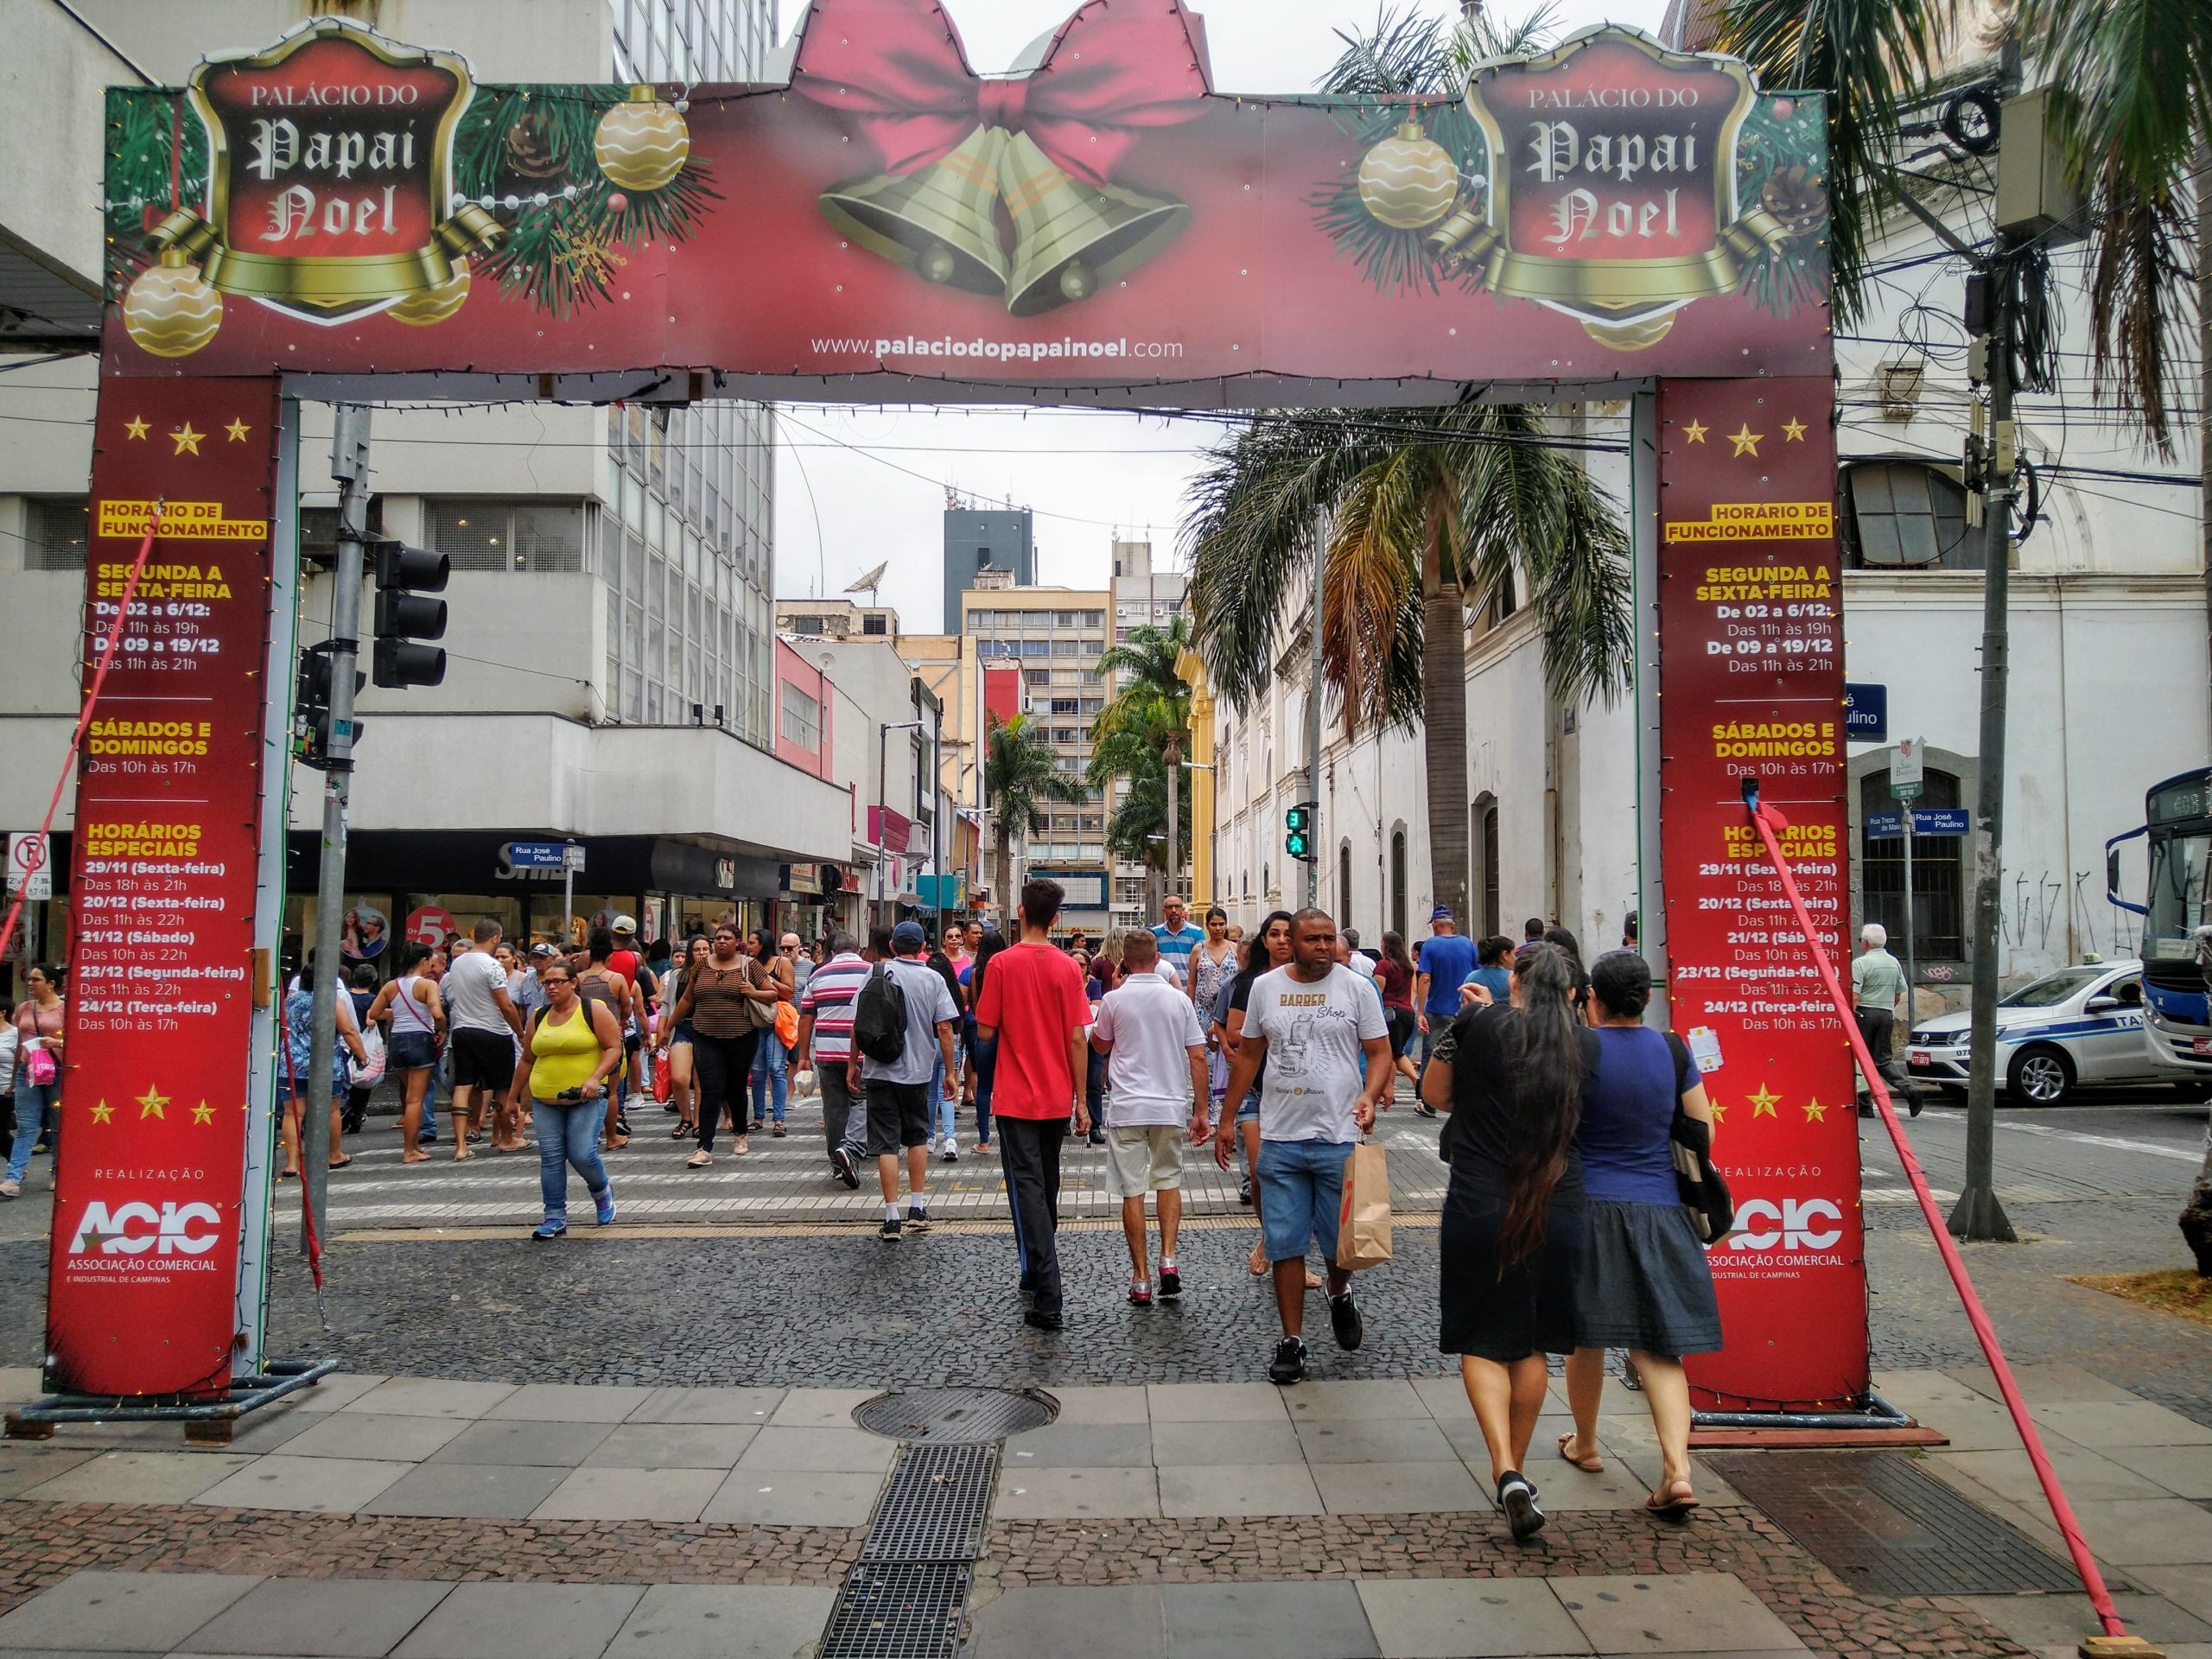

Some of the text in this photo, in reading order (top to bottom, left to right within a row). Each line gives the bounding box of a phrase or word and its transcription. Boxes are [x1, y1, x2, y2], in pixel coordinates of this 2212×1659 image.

[252, 81, 417, 105] PALÁCIO DO
[1529, 84, 1699, 108] PALÁCIO DO
[246, 118, 416, 180] Papai
[1527, 120, 1699, 182] Papai
[260, 184, 398, 241] Noel
[1541, 188, 1681, 243] Noel
[811, 336, 1183, 361] www.palaciodopapainoel.com
[104, 503, 217, 518] HORÁRIO DE
[1716, 504, 1827, 518] HORÁRIO DE
[103, 523, 265, 537] FUNCONAMENTO
[1669, 524, 1828, 538] FUNCIONAMENTO
[99, 564, 222, 580] SEGUNDA A
[1707, 566, 1830, 584] SEGUNDA A
[98, 582, 232, 600] SEXTA-FEIRA
[1697, 582, 1831, 601] SEXTA-FEIRA
[95, 602, 210, 616] De 02 a 6/12:
[1718, 604, 1833, 618] De 02 a 6/12:
[94, 620, 198, 634] Das 11h às 19h
[1728, 623, 1831, 636] Das 11h às 19h
[124, 639, 219, 652] 09 a 19/12
[1707, 639, 1833, 654] De 09 a 19/12
[94, 658, 196, 670] Das 11h às 21h
[1730, 659, 1832, 671] Das 11h às 21h
[1846, 710, 1877, 724] ulino
[90, 718, 210, 736] SÁBADOS E
[1713, 721, 1834, 739] SÁBADOS E
[91, 740, 207, 754] DOMINGOS
[1717, 741, 1834, 757] DOMINGOS
[90, 761, 195, 772] Das 10h às 17h
[1728, 763, 1834, 775] Das 10h às 17h
[89, 821, 200, 839] HORÁRIOS
[86, 842, 197, 856] ESPECIAIS
[86, 862, 225, 876] 29/11 (Sexta-feira)
[1700, 864, 1740, 874] 29/11
[86, 877, 186, 890] Das 18h às 21h
[1738, 880, 1836, 891] Das às 21h
[84, 896, 225, 911] 20/12 (Sexta-feira)
[1700, 898, 1741, 909] 20/12
[84, 914, 183, 925] Das 11h às 22h
[1739, 915, 1837, 927] Das 11h 22h
[82, 931, 194, 945] 21/12 (Sábado)
[1728, 932, 1768, 943] 21/12
[83, 948, 187, 960] Das 10h às 22h
[1736, 947, 1808, 960] Das 10h às
[81, 966, 244, 980] 23/12 (Segunda-feira)
[1677, 967, 1720, 979] 23/12
[81, 982, 181, 995] Das 11h às 22h
[1742, 982, 1808, 995] Das 11h às
[79, 999, 217, 1015] 24/12 (Terça-feira)
[1280, 994, 1326, 1006] BARBER
[1705, 1001, 1747, 1013] 24/12
[1317, 1007, 1346, 1021] Shop
[2118, 1015, 2143, 1027] TAX
[79, 1017, 177, 1030] Das 10h às 17h
[1744, 1018, 1840, 1029] Das 10h às 17h
[96, 1168, 203, 1179] REALIZAÇÃO
[68, 1201, 221, 1254] ACIC
[68, 1258, 216, 1272] ASSOCIAÇÃO COMERCIAL
[1777, 1255, 1844, 1265] COMERCIAL
